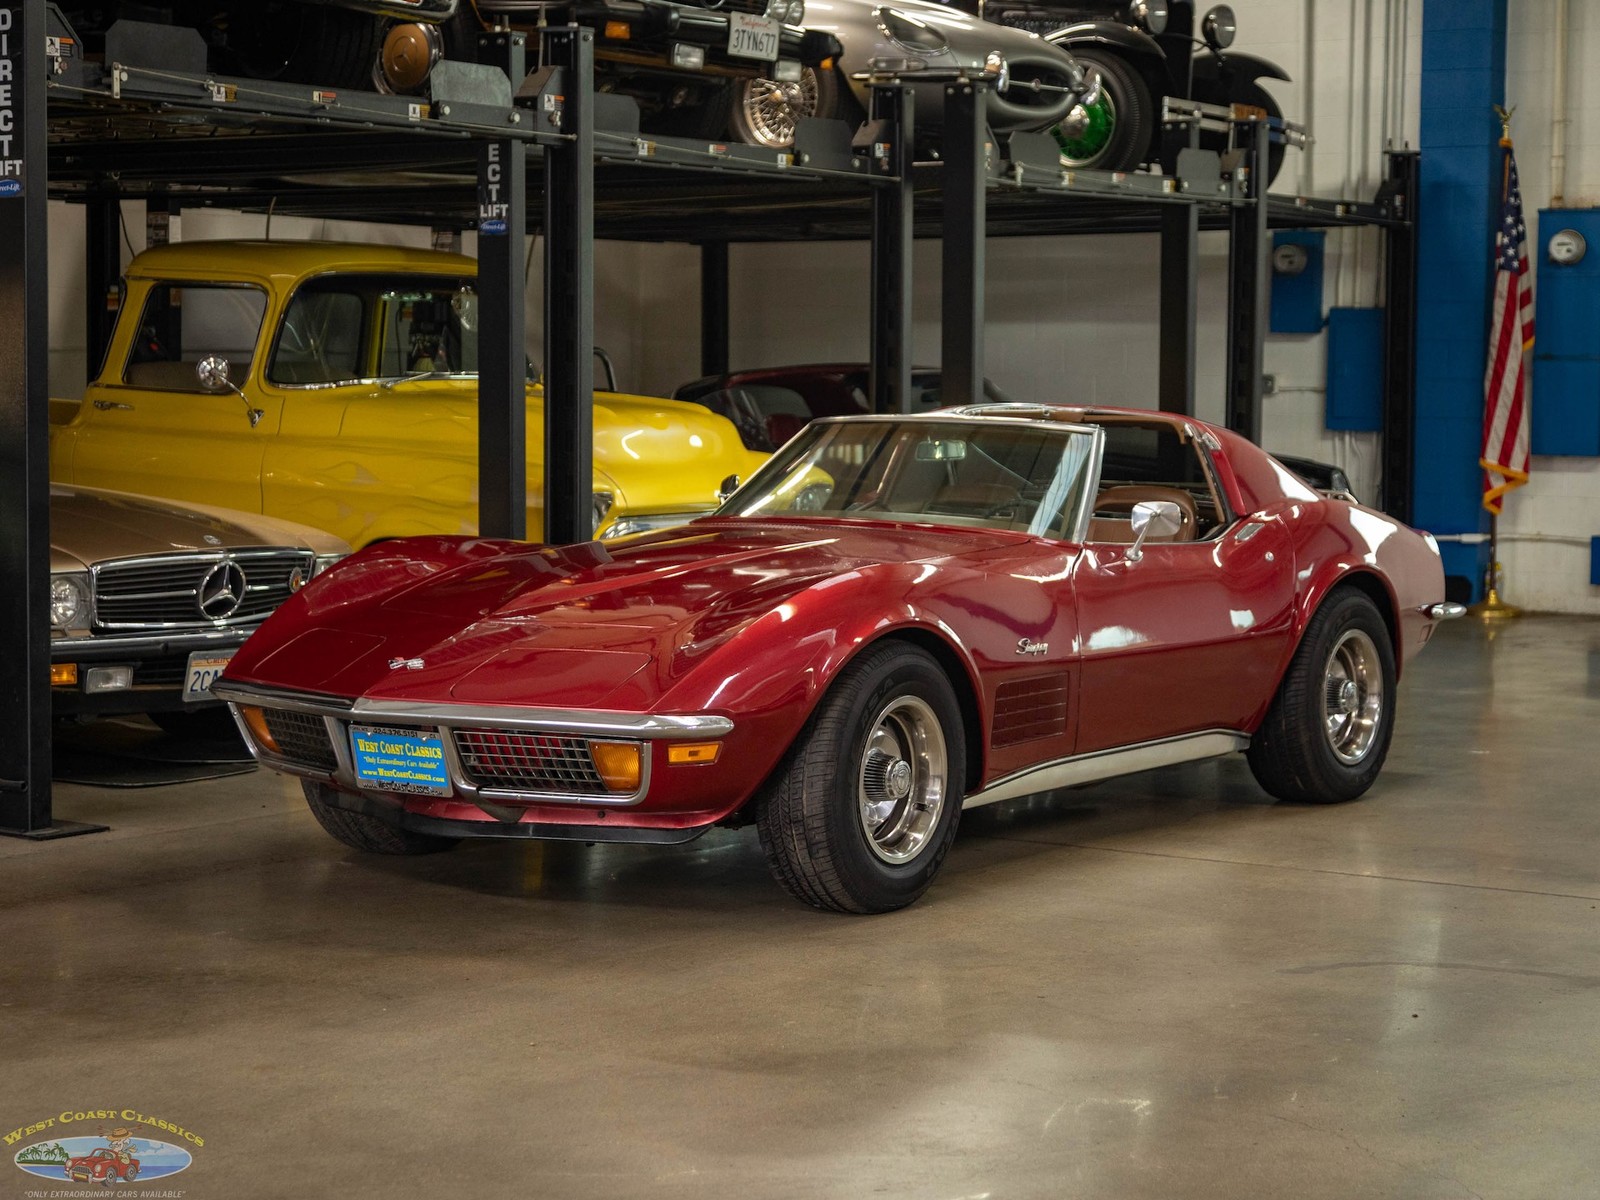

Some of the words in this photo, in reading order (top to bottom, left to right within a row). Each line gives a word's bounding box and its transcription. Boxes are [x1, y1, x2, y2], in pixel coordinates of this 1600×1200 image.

[733, 29, 776, 54] 3TYN677
[0, 9, 13, 157] DIRECT
[0, 160, 23, 176] IFT
[487, 143, 501, 202] ECT
[480, 203, 509, 218] LIFT
[357, 739, 379, 753] WEST
[380, 741, 404, 755] COAST
[405, 743, 442, 759] CLASSICS
